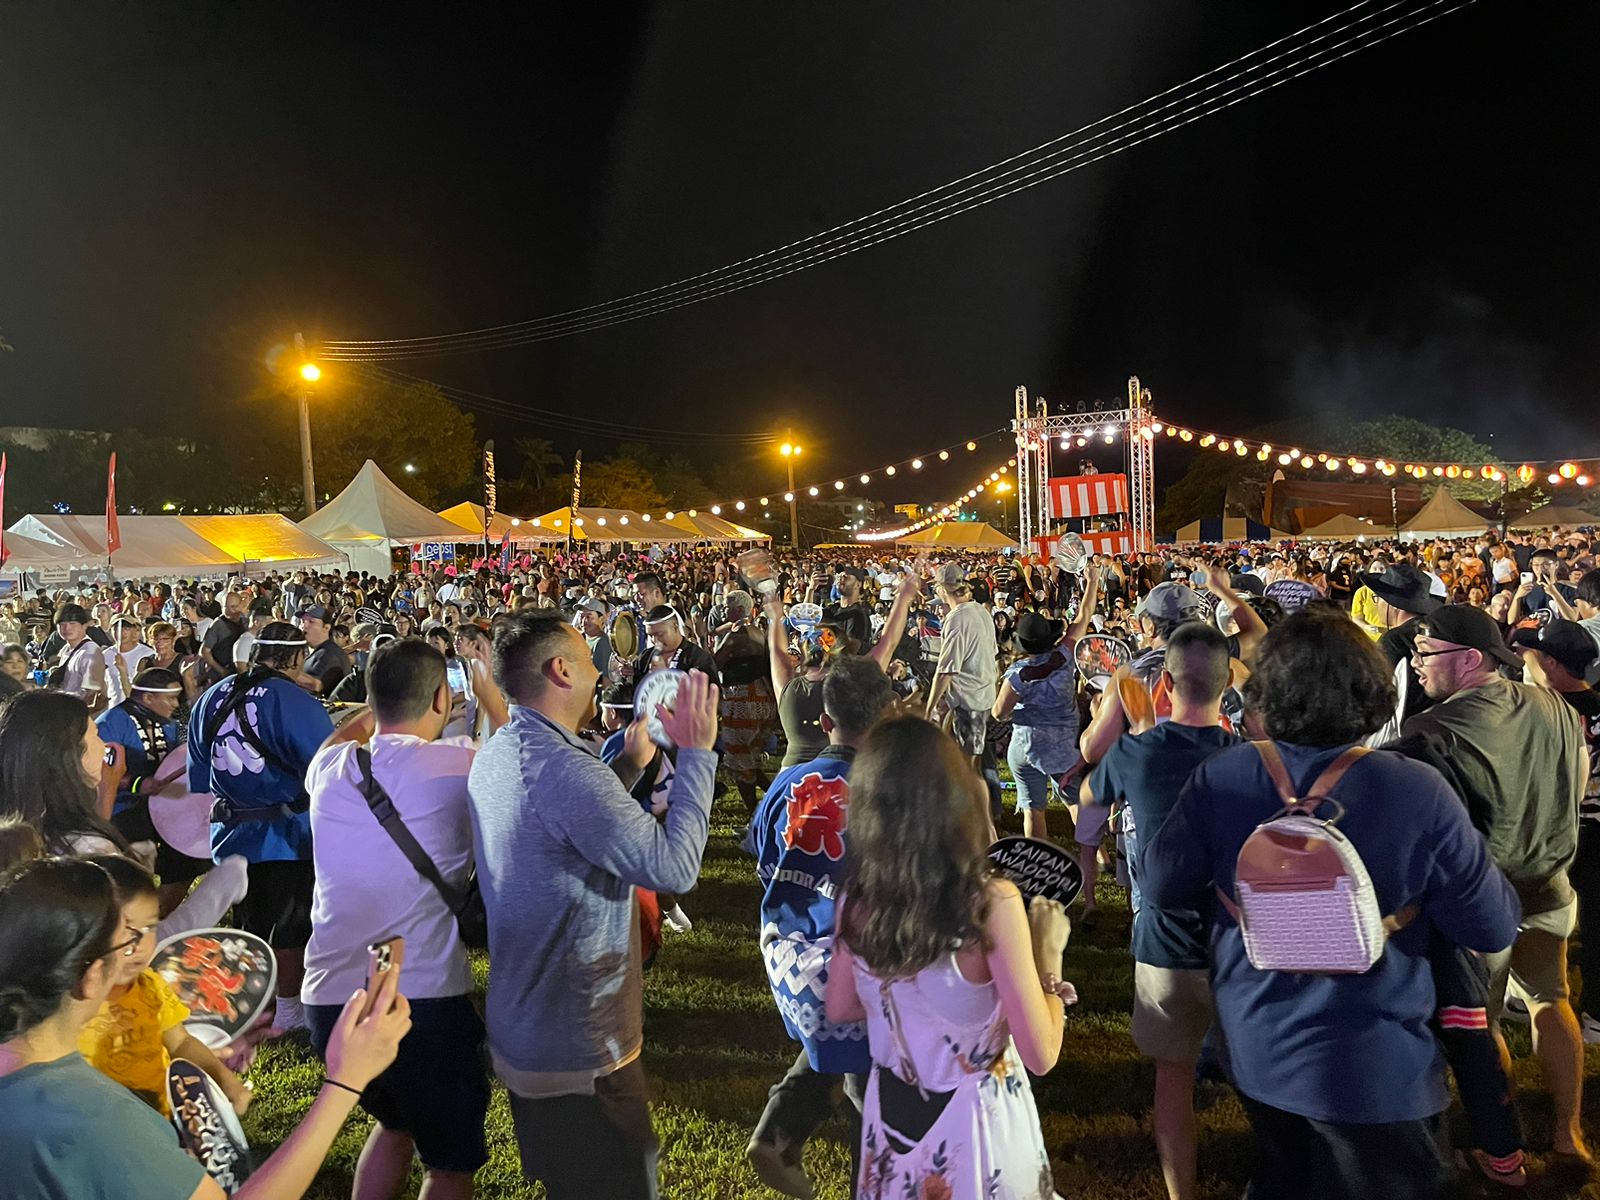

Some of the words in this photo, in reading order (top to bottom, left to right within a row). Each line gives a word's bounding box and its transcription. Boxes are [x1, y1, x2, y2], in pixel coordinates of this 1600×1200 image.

[485, 450, 496, 482] Asahi
[485, 483, 497, 515] Asahi
[987, 849, 1078, 892] AWAODORI
[1010, 841, 1073, 874] SAIPAN
